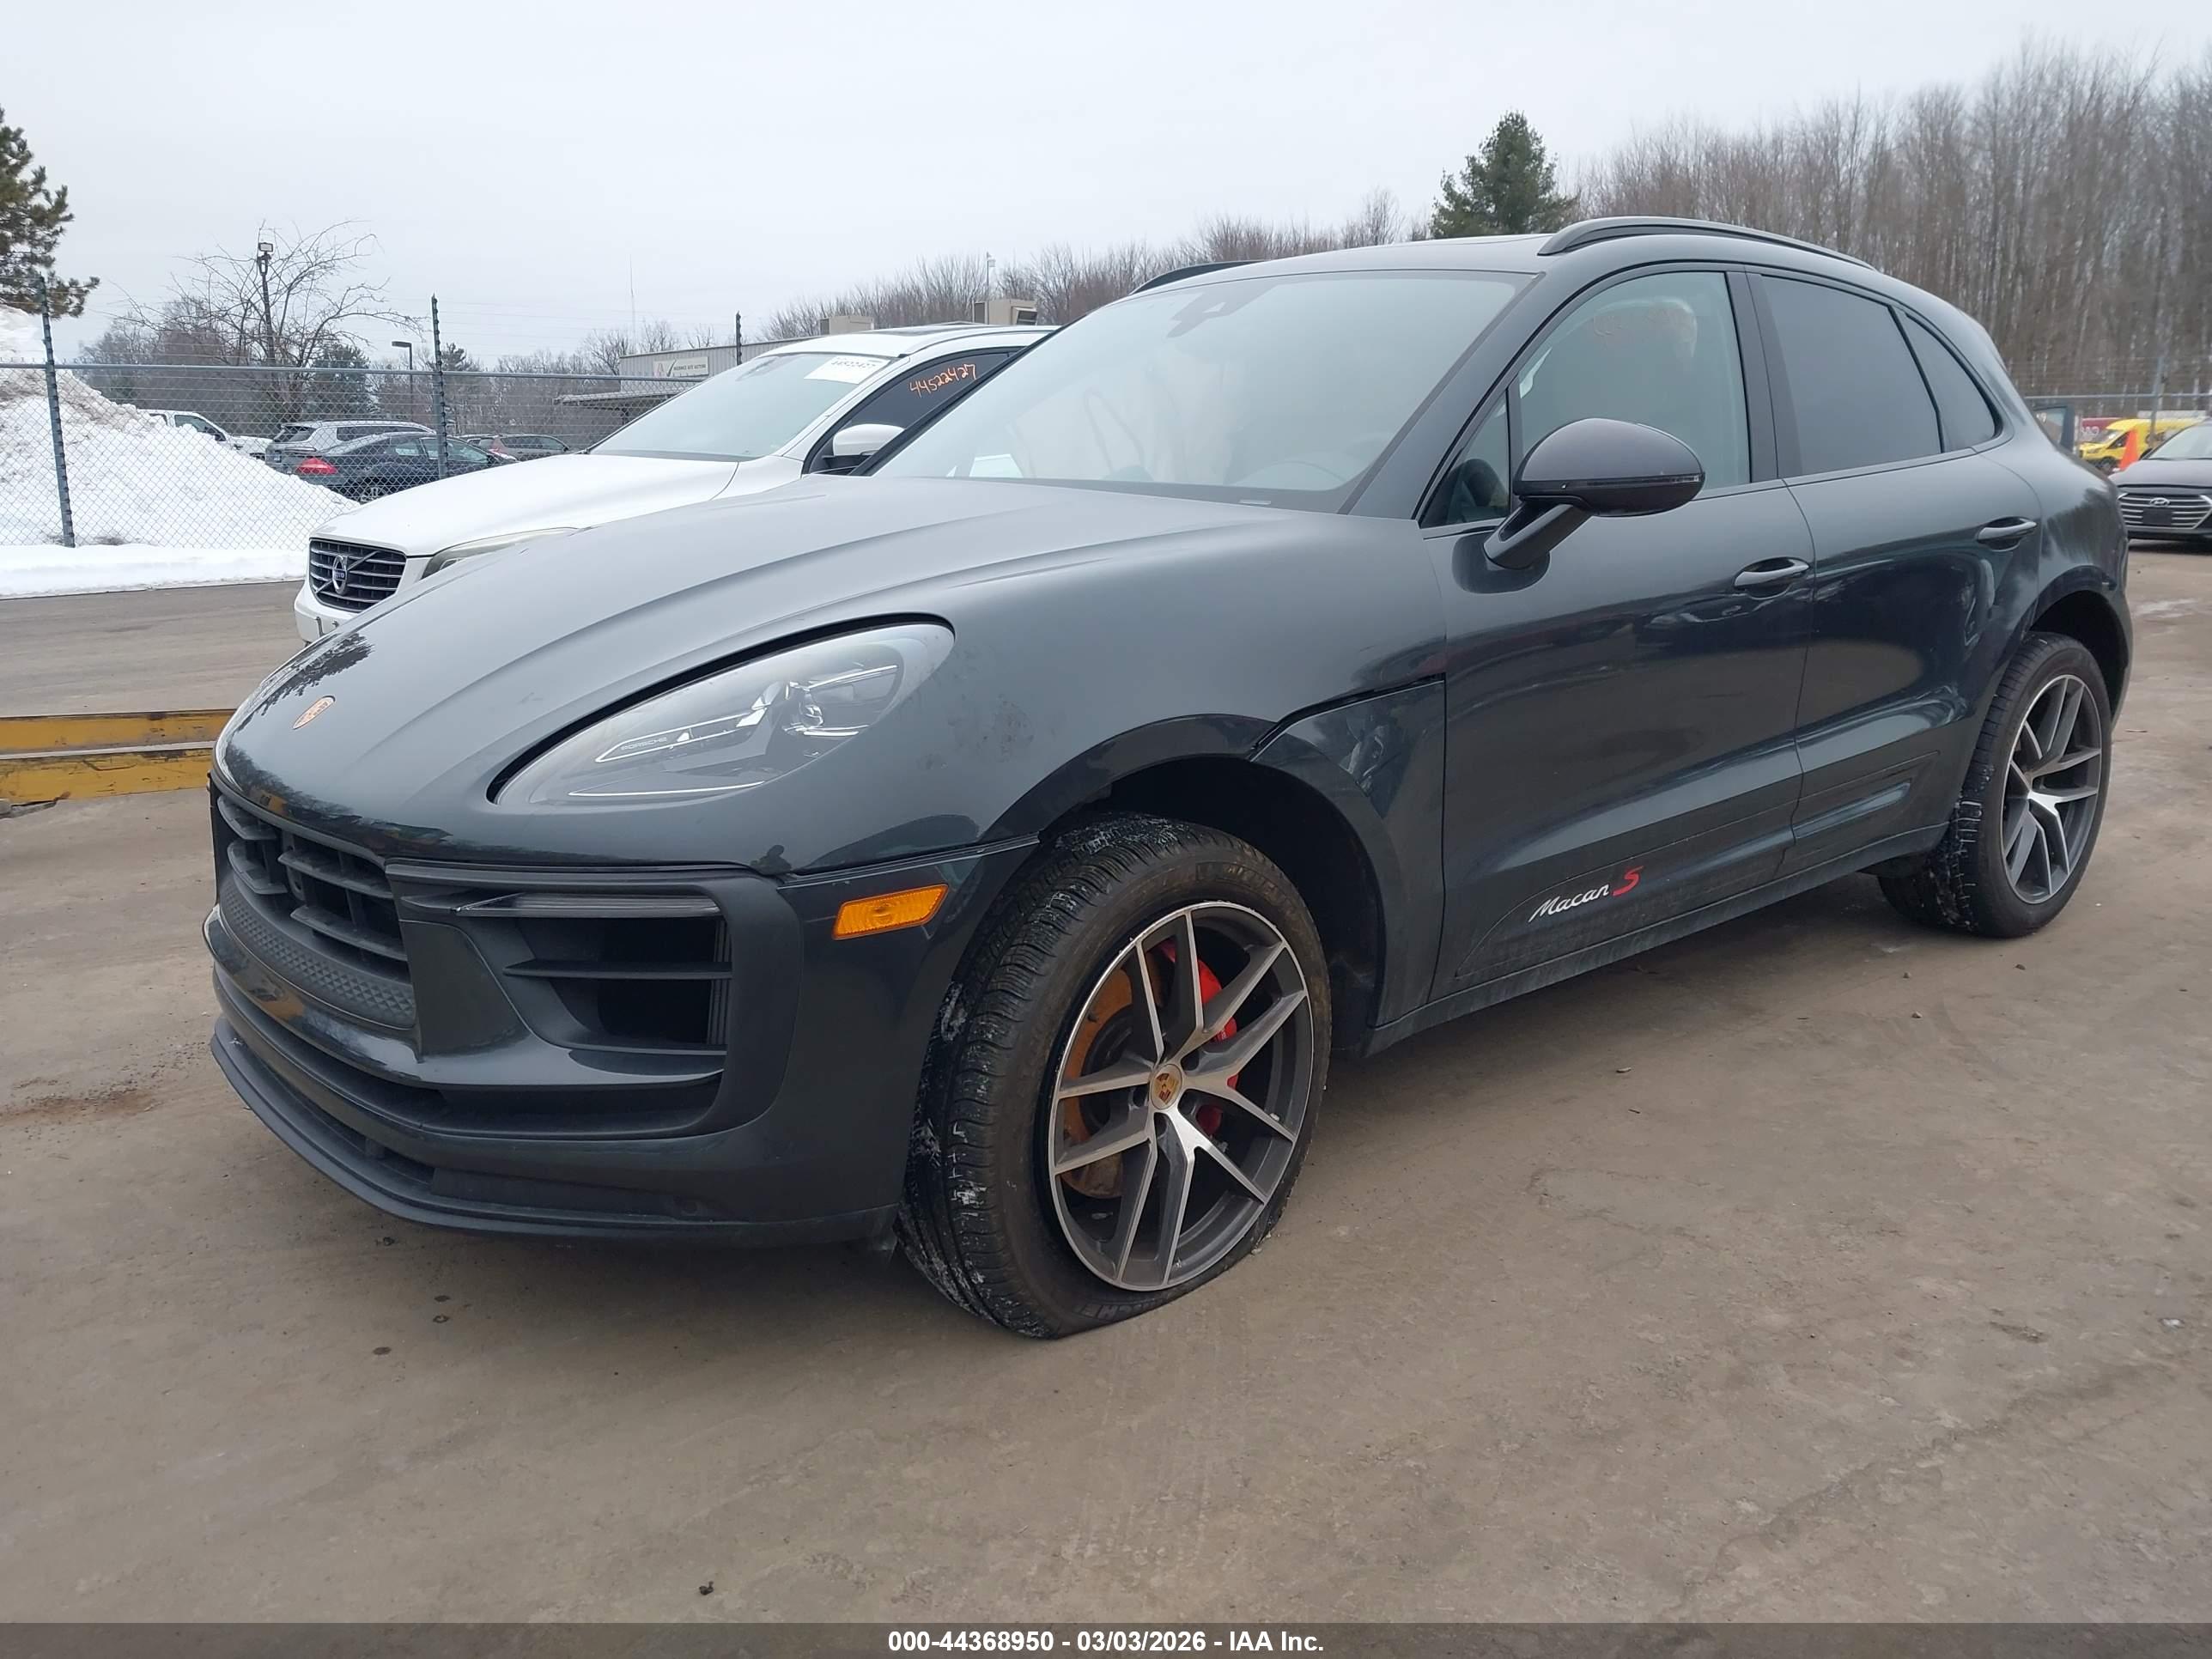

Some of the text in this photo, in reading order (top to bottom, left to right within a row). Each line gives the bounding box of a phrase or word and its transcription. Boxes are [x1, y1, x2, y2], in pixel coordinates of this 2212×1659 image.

[909, 363, 977, 398] 44522427
[1528, 866, 1644, 923] Macan S
